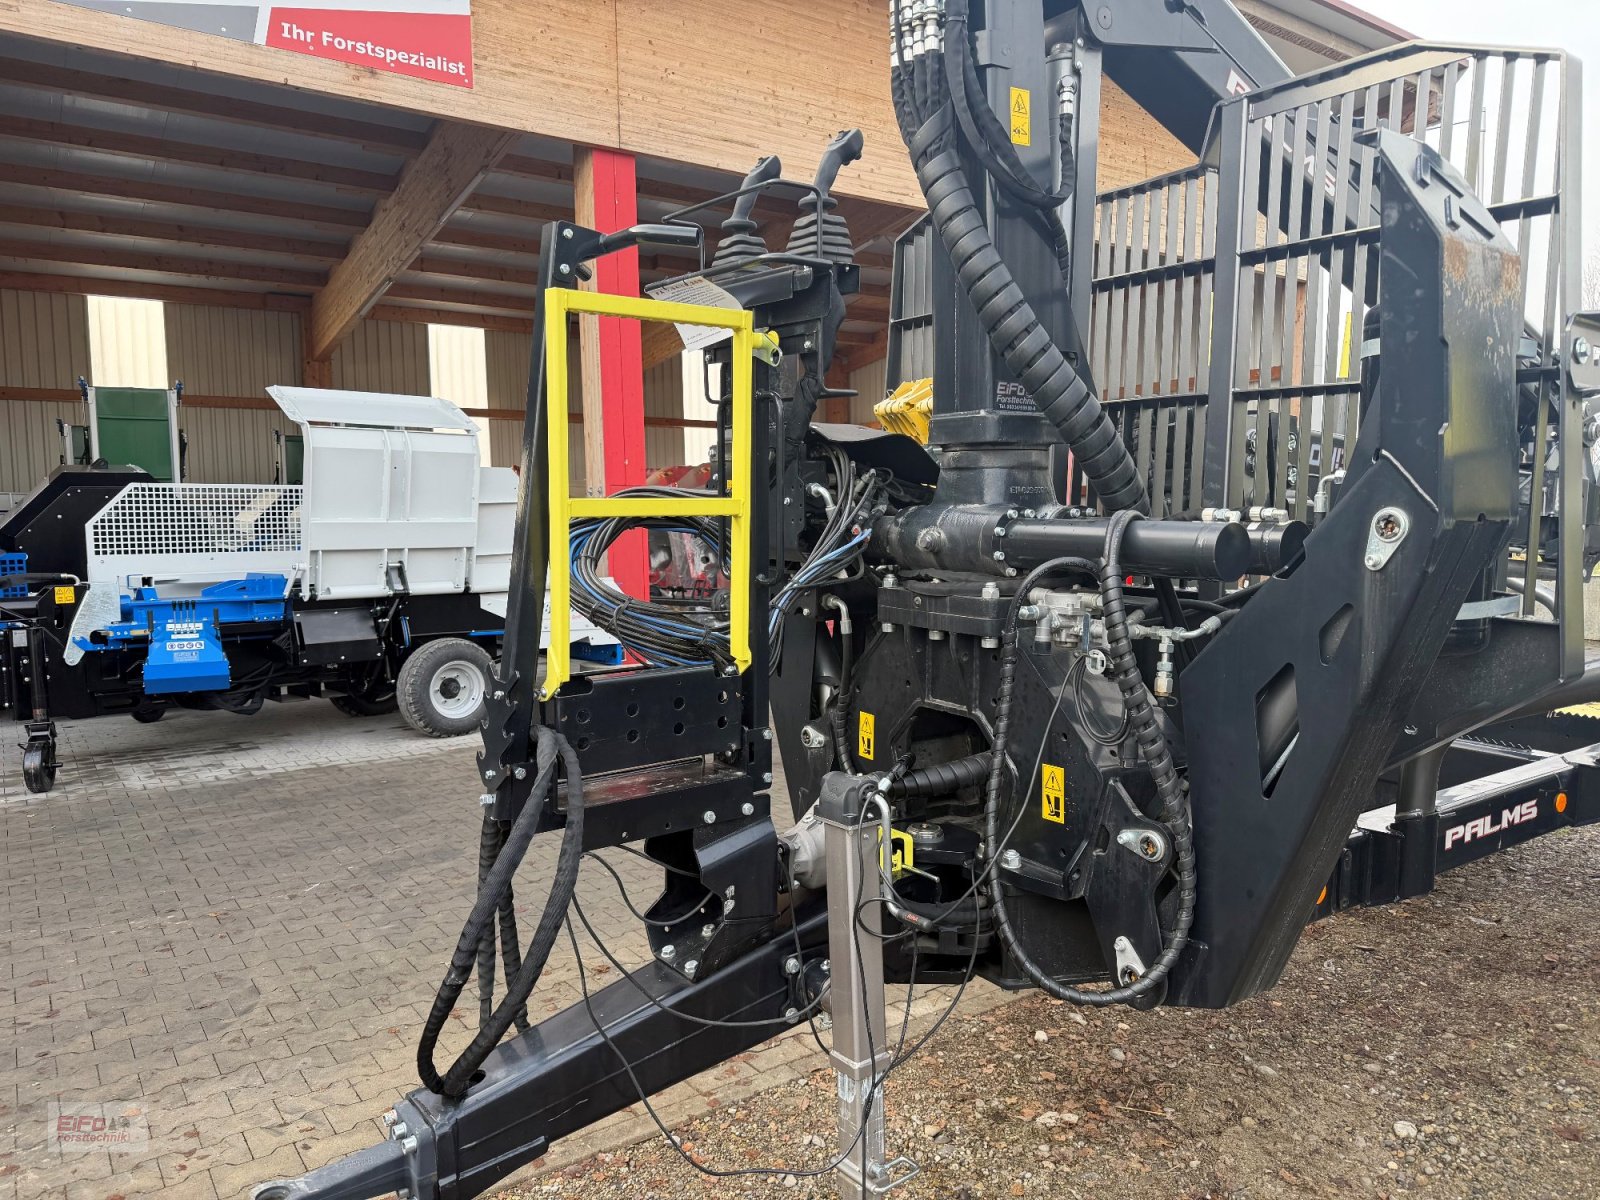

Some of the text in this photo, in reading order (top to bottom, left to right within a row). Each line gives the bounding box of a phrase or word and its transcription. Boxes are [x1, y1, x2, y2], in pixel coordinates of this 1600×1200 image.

[281, 22, 466, 76] Ihr Forstspezialist
[1444, 798, 1538, 851] PALMS
